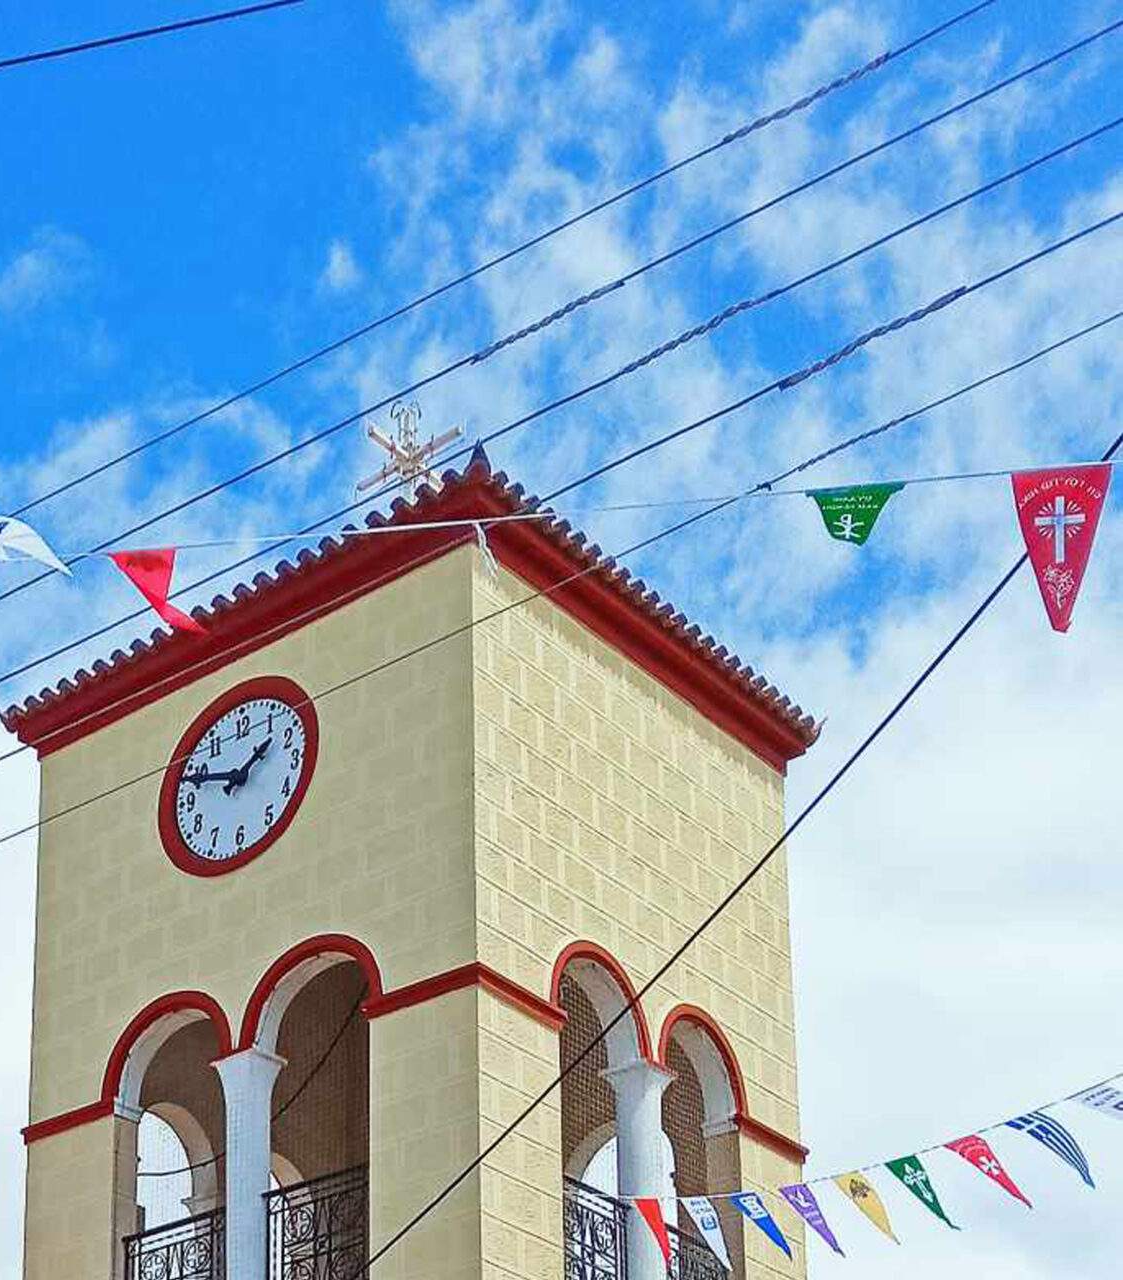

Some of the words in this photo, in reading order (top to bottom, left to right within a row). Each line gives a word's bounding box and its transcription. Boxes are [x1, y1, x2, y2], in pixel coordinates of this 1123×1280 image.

[236, 715, 251, 740] 12
[267, 713, 274, 734] 1
[209, 736, 222, 759] 11
[284, 727, 294, 749] 2
[290, 748, 300, 770] 3
[281, 776, 291, 798] 4
[187, 792, 196, 813] 9
[193, 813, 203, 834] 8
[264, 804, 274, 826] 5
[210, 826, 220, 848] 7
[235, 825, 245, 846] 6
